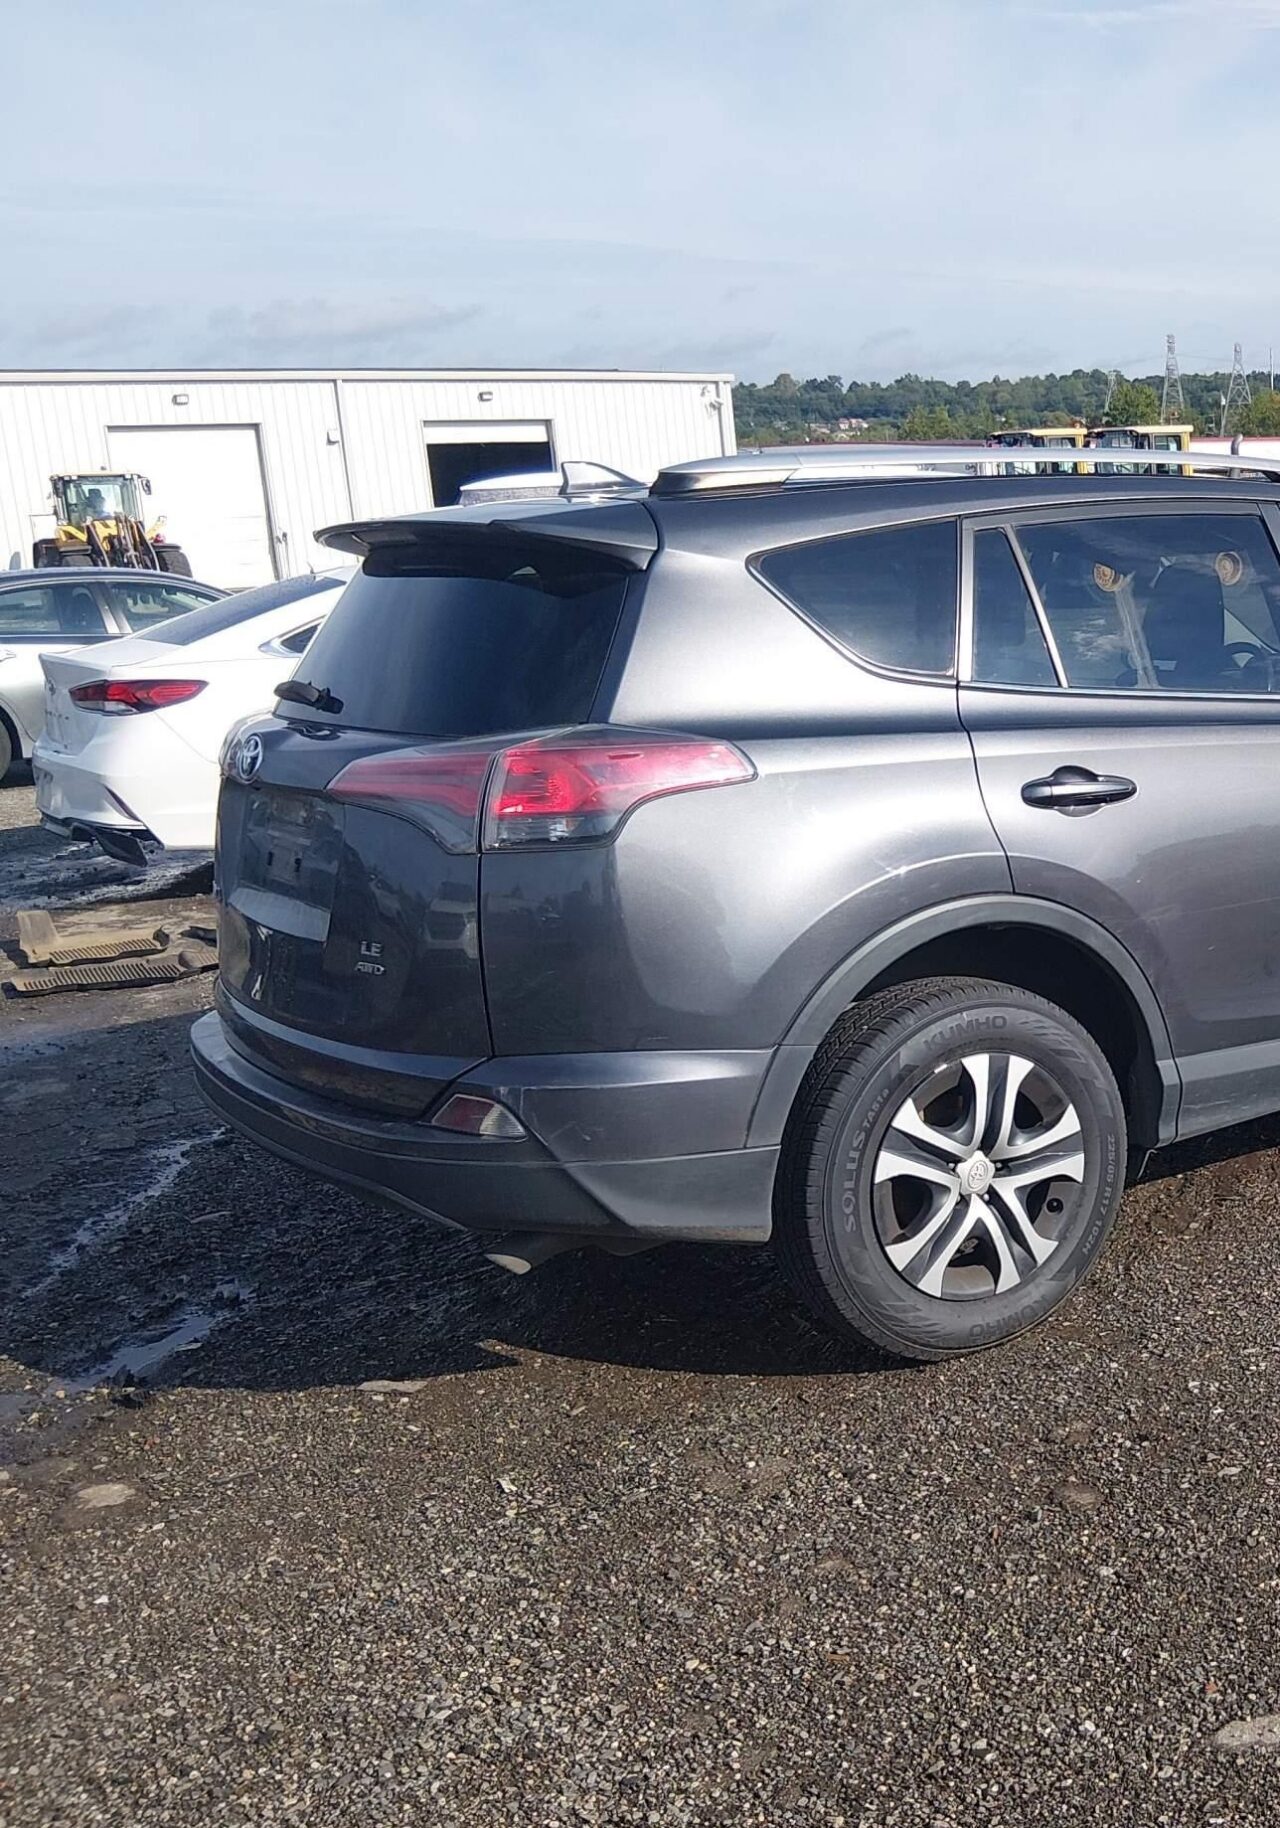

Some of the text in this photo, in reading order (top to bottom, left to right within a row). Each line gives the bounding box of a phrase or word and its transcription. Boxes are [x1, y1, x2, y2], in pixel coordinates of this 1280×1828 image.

[360, 940, 381, 957] LE
[922, 1015, 1008, 1050] KUMHO
[842, 1129, 866, 1233] SOLUS
